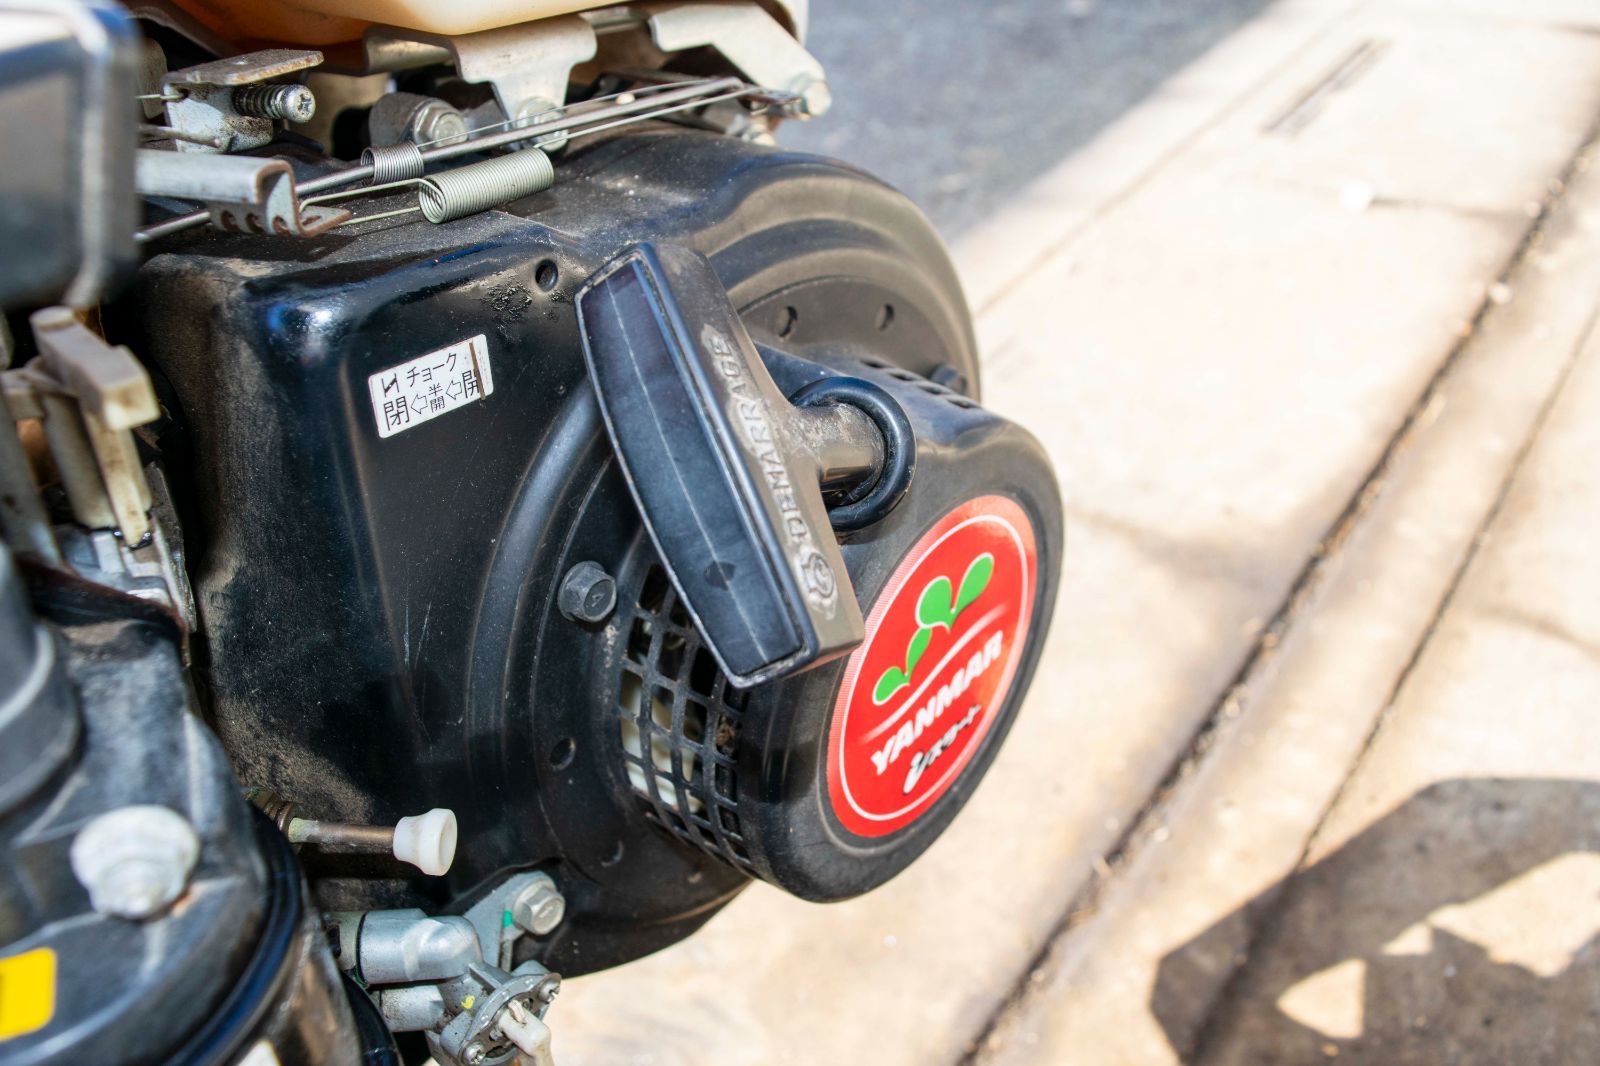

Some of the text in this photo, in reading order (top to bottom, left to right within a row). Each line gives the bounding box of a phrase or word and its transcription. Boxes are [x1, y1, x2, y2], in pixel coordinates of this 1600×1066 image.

[406, 353, 457, 387] チョーク
[383, 395, 410, 431] 閉
[871, 630, 1003, 776] YANMAR
